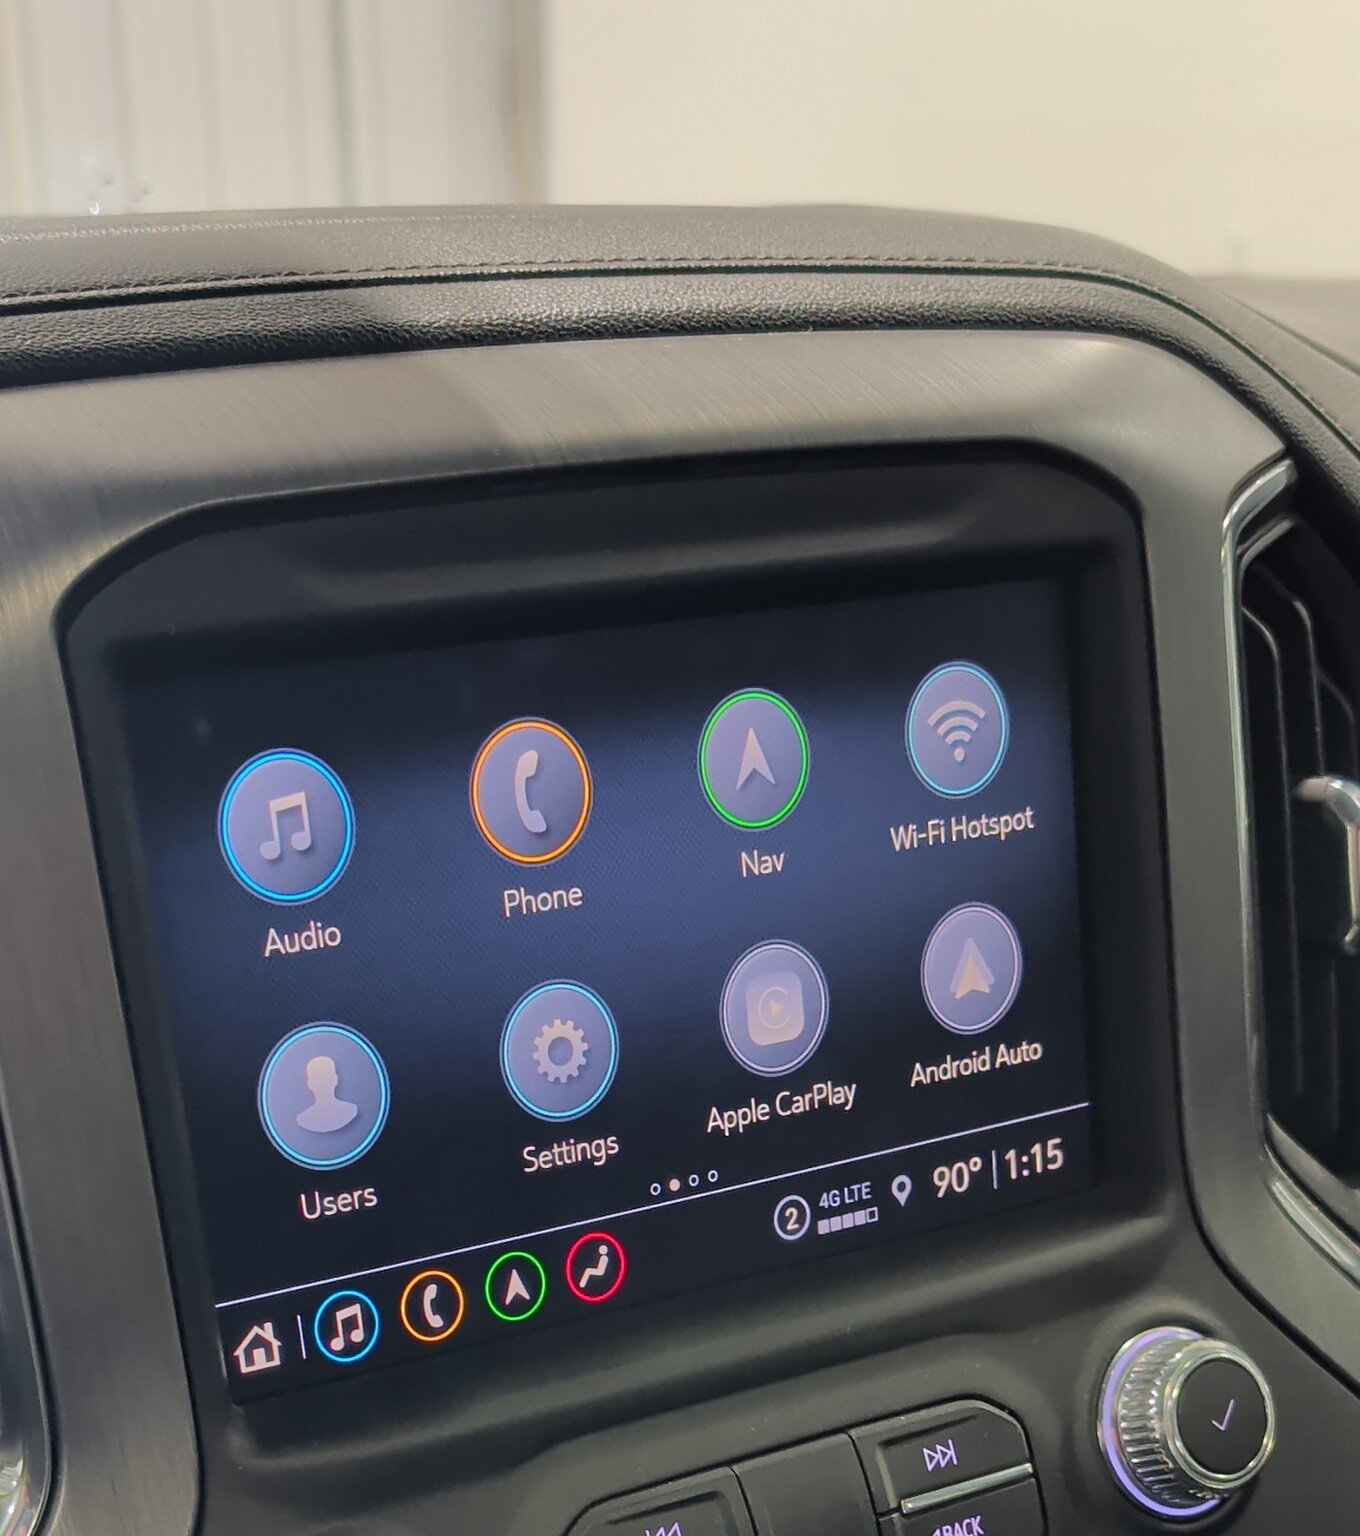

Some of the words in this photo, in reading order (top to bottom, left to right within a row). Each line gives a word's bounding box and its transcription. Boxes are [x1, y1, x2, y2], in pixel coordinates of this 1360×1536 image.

[889, 818, 946, 852] Wi-Fi
[950, 805, 1035, 842] Hotspot
[740, 849, 785, 878] Nav
[503, 886, 583, 918] Phone
[264, 919, 342, 958] Audio
[910, 1046, 991, 1088] Android
[994, 1039, 1043, 1070] Auto
[706, 1097, 771, 1137] Apple
[774, 1080, 857, 1118] CarPlay
[522, 1135, 619, 1173] Settings
[1004, 1137, 1065, 1181] 1:15
[300, 1186, 378, 1220] Users
[818, 1189, 842, 1209] 4G
[843, 1181, 873, 1205] LTE
